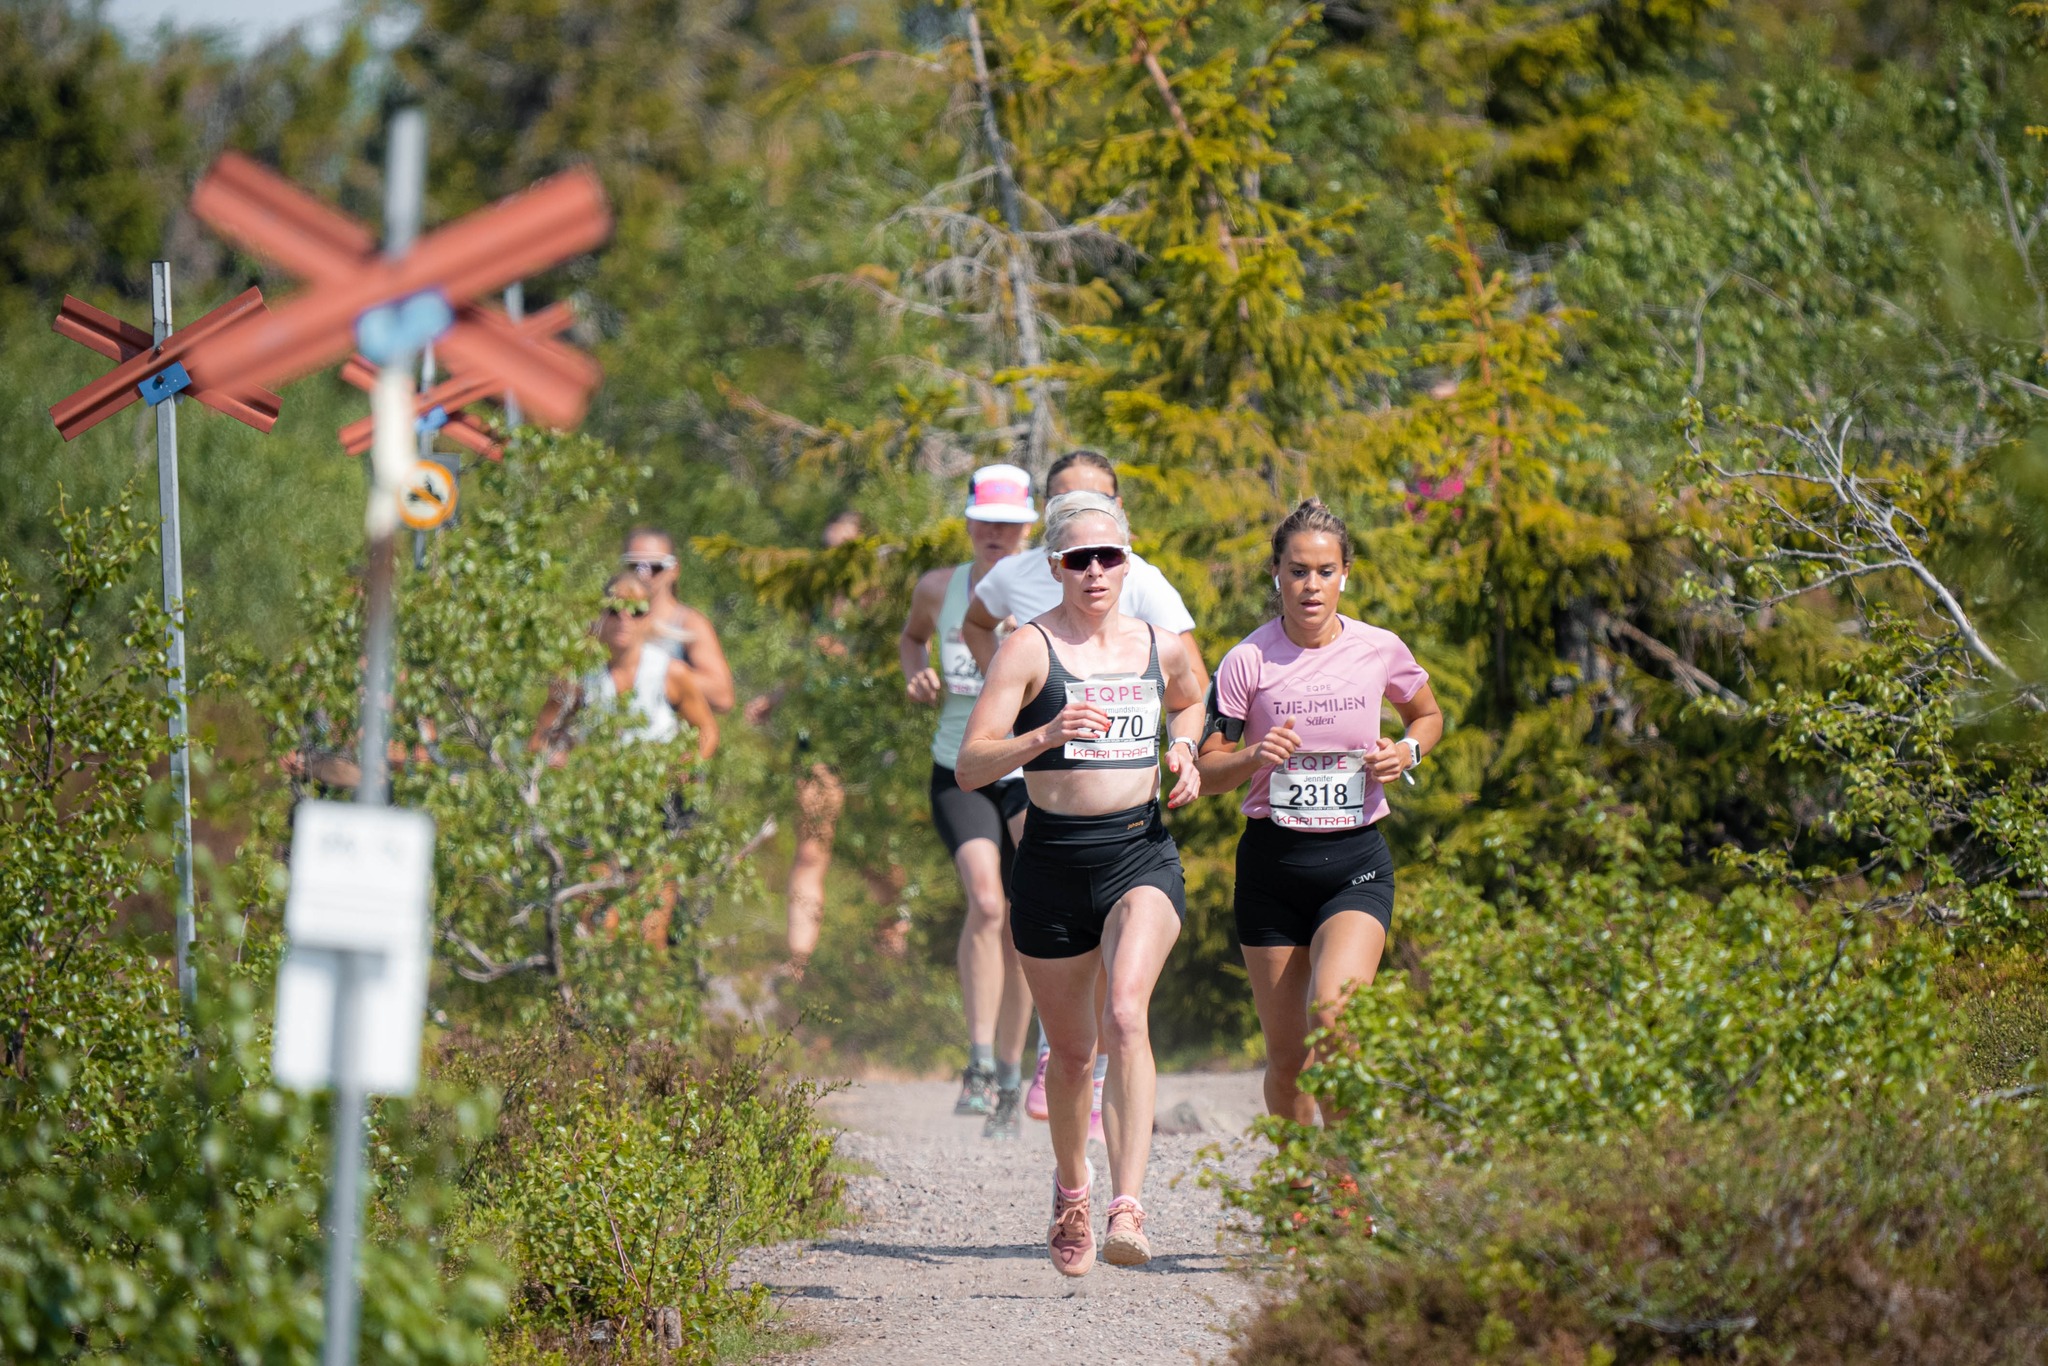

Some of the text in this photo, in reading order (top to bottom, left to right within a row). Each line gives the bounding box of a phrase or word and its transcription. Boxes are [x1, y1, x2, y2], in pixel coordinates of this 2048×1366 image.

[1085, 686, 1143, 702] EQPE
[1306, 684, 1331, 692] EQPE
[1273, 696, 1365, 715] TJEJMILEN
[1091, 715, 1143, 739] 770
[1073, 748, 1110, 758] KARI
[1288, 754, 1348, 771] EQPE
[1289, 784, 1348, 806] 2318
[1277, 816, 1312, 825] KARI
